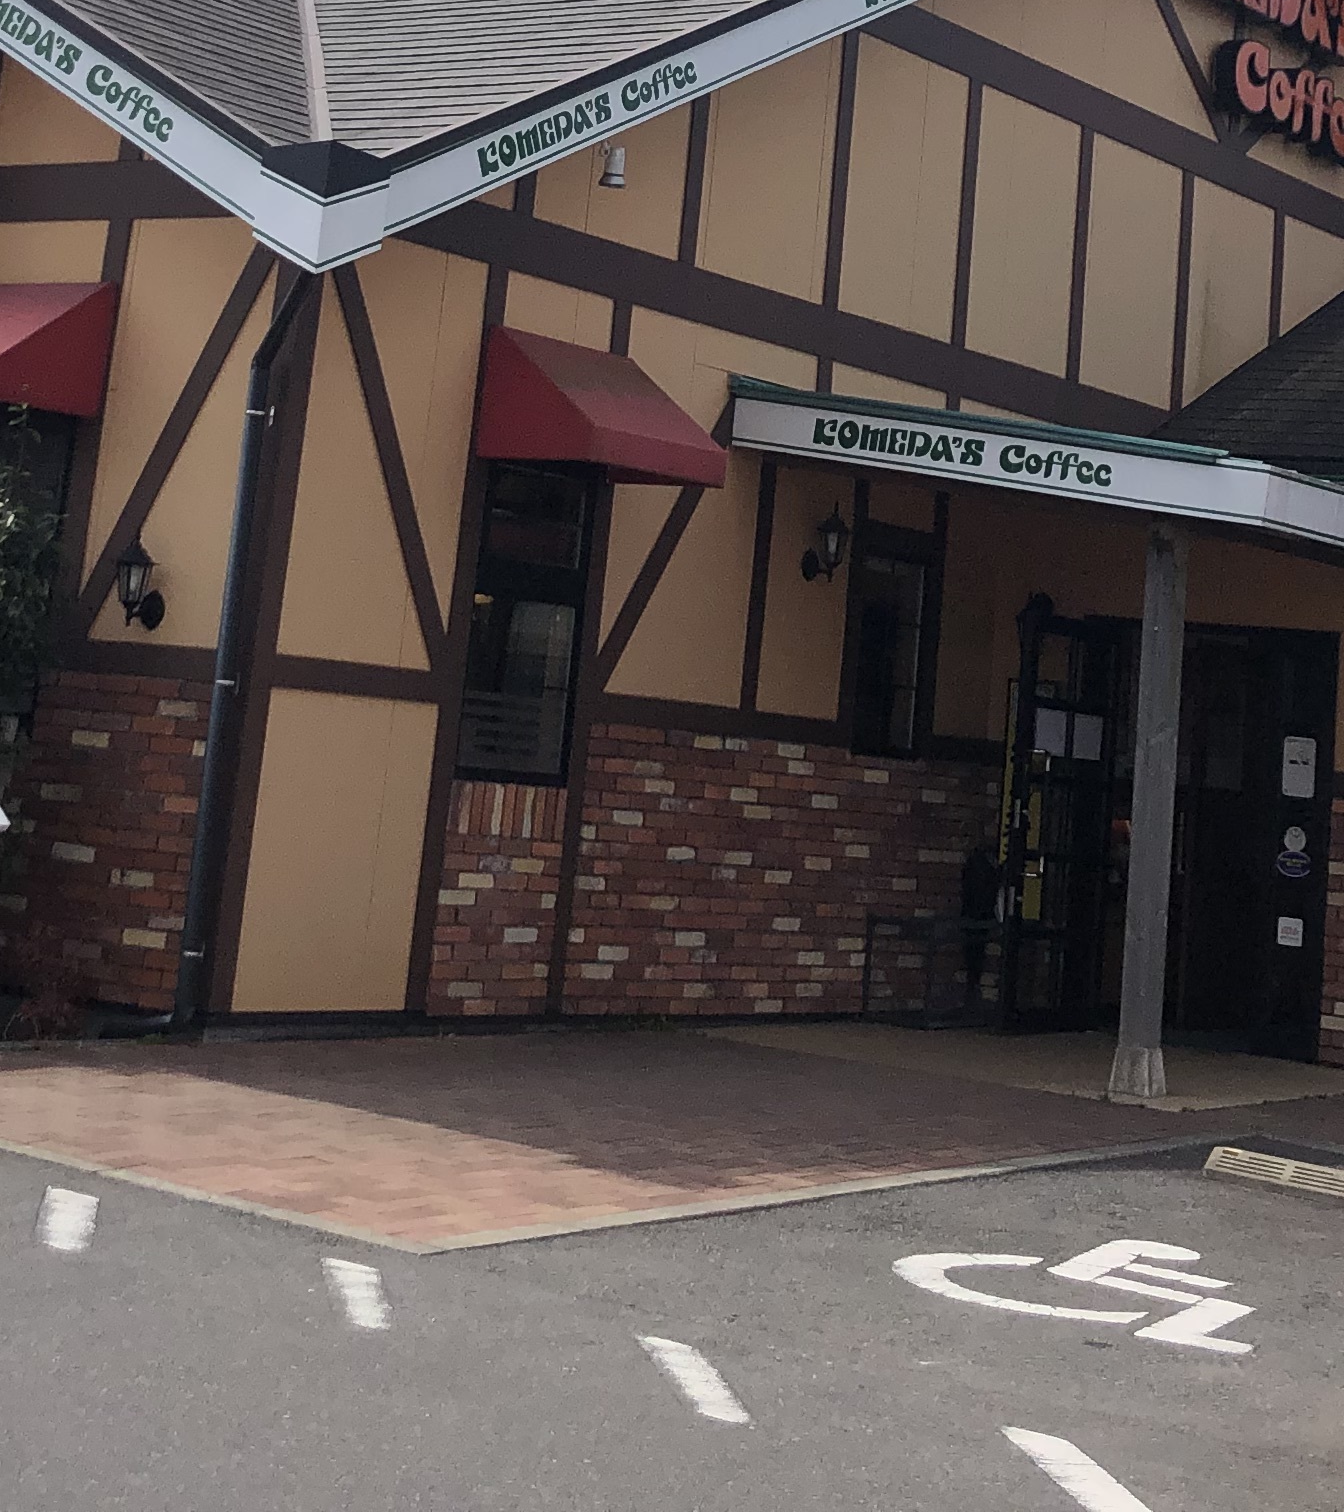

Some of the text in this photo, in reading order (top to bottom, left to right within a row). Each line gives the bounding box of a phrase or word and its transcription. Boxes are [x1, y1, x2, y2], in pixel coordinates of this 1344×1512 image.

[85, 63, 175, 145] Coffee
[478, 59, 698, 177] KOMEDA'S Coffee
[813, 416, 1113, 488] KOMEDA'S Coffee
